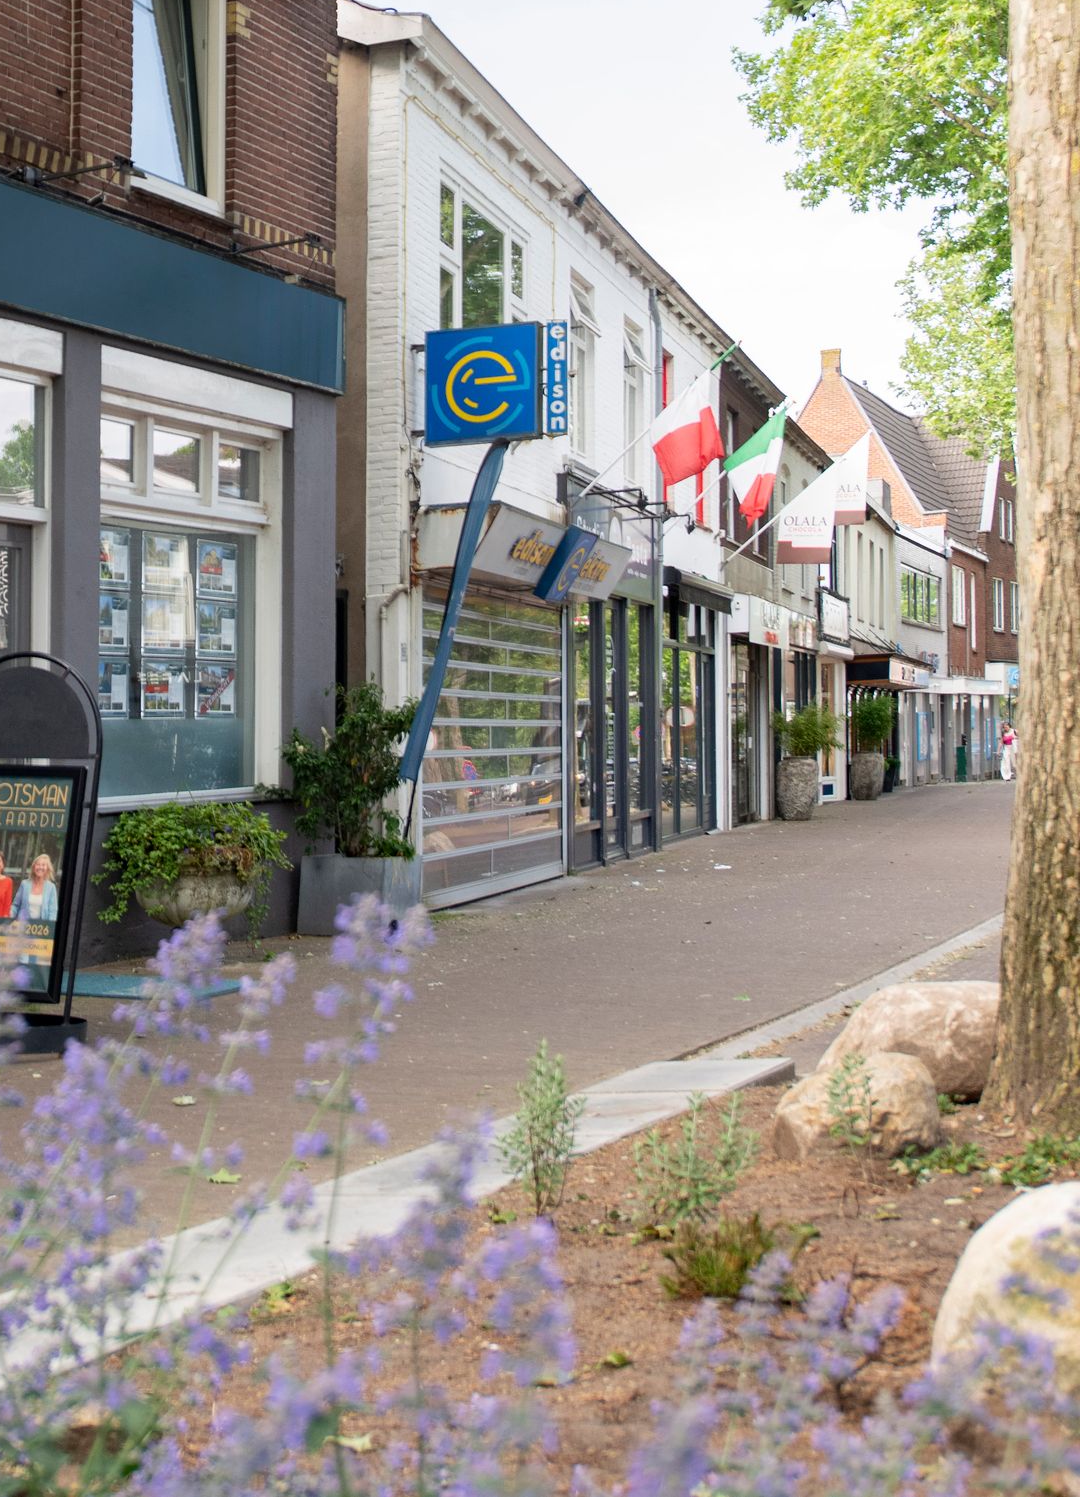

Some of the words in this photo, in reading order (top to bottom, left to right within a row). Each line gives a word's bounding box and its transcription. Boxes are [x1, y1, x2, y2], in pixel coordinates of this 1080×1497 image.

[550, 325, 566, 430] edison
[784, 515, 828, 527] OLALA
[25, 924, 49, 935] 2026
